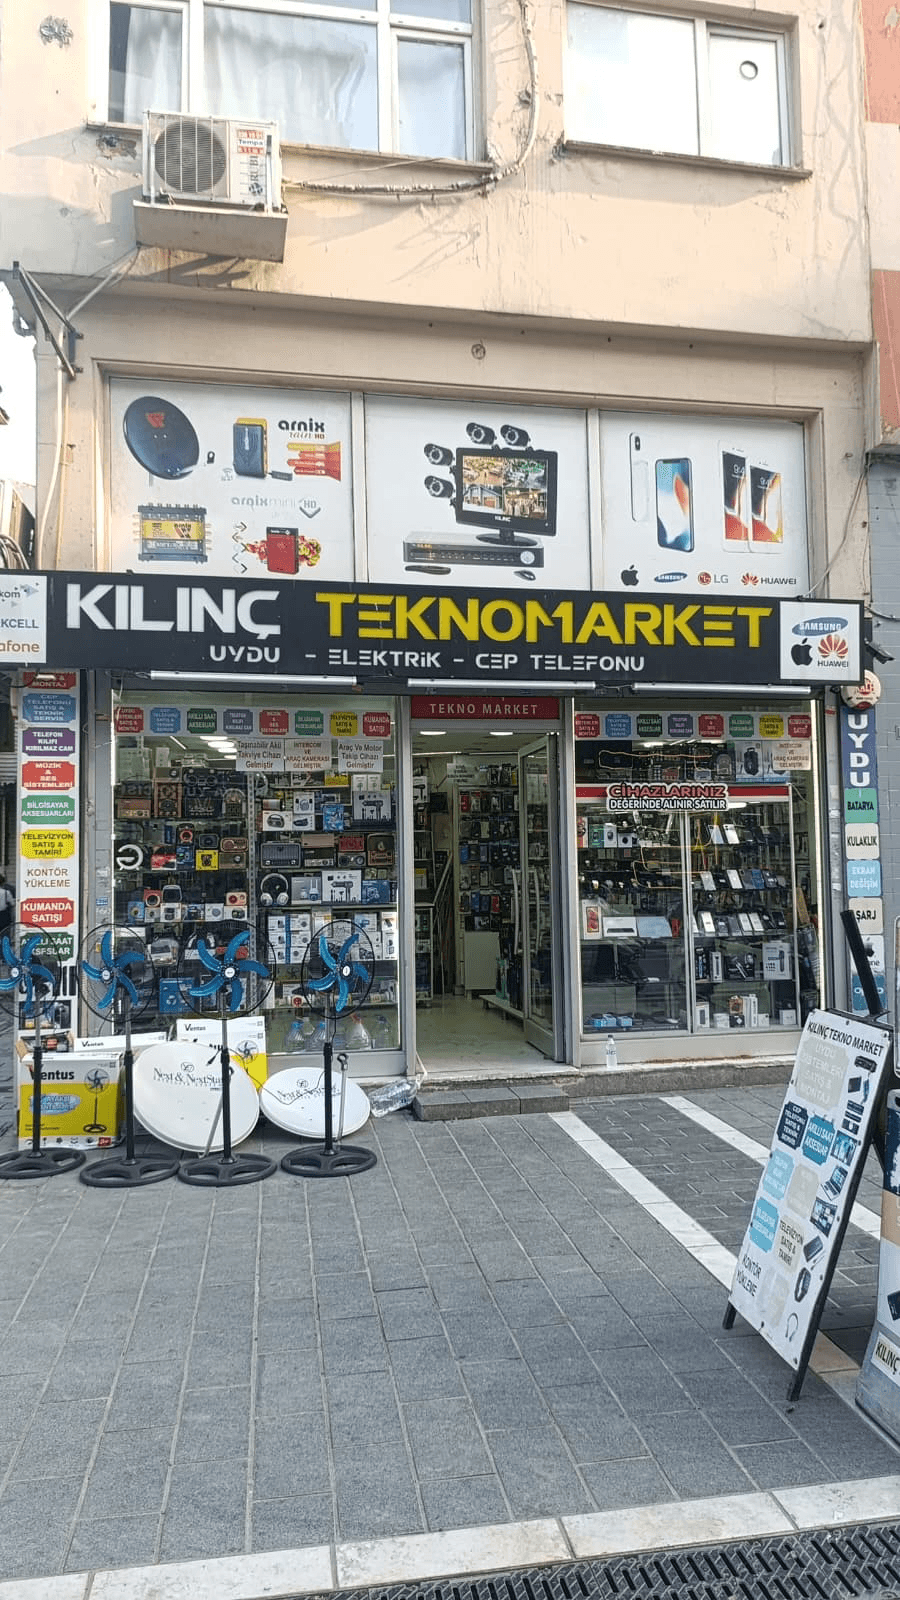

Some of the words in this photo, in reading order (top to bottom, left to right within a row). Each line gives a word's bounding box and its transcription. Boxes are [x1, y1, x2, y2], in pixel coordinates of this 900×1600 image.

[278, 418, 325, 432] arnix
[714, 574, 728, 584] LG
[761, 577, 797, 585] HUAWEI
[66, 583, 281, 639] KILINÇ
[315, 592, 773, 648] TEKNOMARKET
[799, 622, 842, 632] SAMSUNG
[209, 645, 281, 663] UYDU
[476, 653, 518, 669] CEP
[530, 654, 645, 672] TELEFONU
[818, 660, 849, 668] HUAWEI
[429, 703, 476, 714] TEKNO
[482, 703, 538, 715] MARKET
[338, 743, 354, 752] Araç
[364, 744, 383, 752] Motor
[847, 714, 871, 787] UYDU
[346, 761, 375, 769] Gelmiştir
[610, 783, 726, 798] CİHAZLARINIZ
[27, 800, 69, 808] BİLGİSAYAR
[610, 798, 661, 809] DEĞERİNDE
[662, 799, 693, 809] ALINIR
[694, 798, 726, 809] SATILIR
[847, 800, 875, 811] BATARYA
[22, 831, 74, 840] TELEVİZYON
[847, 836, 878, 847] KULAKLIK
[27, 866, 69, 877] KONTÖR
[24, 878, 71, 888] YÜKLEME
[22, 902, 73, 911] KUMANDA
[31, 914, 63, 924] SATIŞI
[856, 910, 877, 922] ŞARJ
[807, 1021, 830, 1040] KILINÇ
[829, 1028, 853, 1046] TEKNO
[852, 1036, 885, 1057] MARKET
[153, 1067, 173, 1081] Next
[174, 1071, 184, 1083] &
[742, 1254, 763, 1279] KONTÖR
[736, 1270, 758, 1298] YÜKLEME
